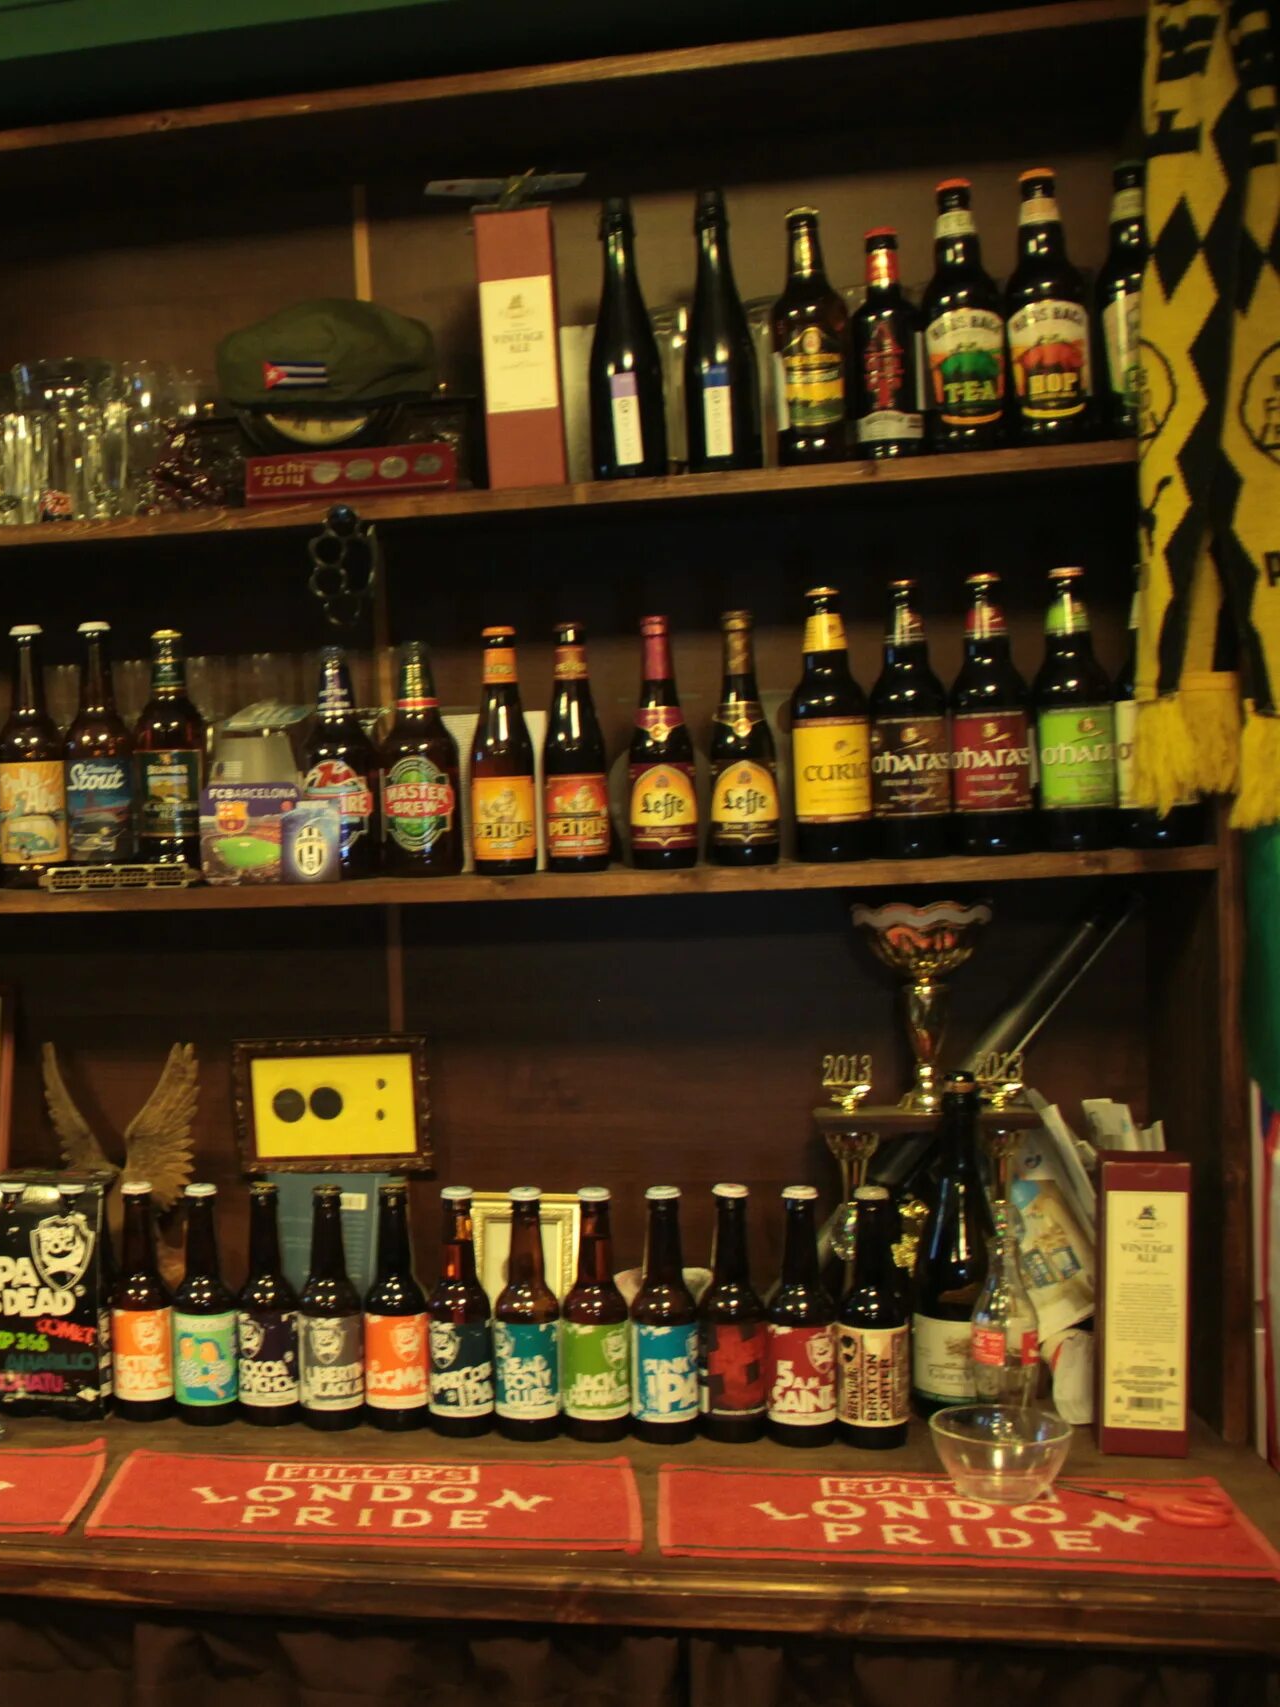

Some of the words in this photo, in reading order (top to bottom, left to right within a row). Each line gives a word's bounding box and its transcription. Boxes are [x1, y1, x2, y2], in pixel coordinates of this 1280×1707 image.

[943, 379, 998, 404] TEA
[66, 763, 127, 791] Stout
[386, 784, 448, 802] MASTER
[639, 792, 685, 820] Leffe
[721, 789, 767, 816] Leffe
[474, 820, 533, 839] PETRUS
[548, 817, 608, 838] PETRUS
[822, 1054, 872, 1083] 2013
[3, 1287, 77, 1317] DEAD
[35, 1319, 97, 1345] COMET
[647, 1372, 699, 1413] IPA
[866, 1353, 878, 1422] BRIXTON
[879, 1357, 891, 1422] PORTER
[281, 1465, 466, 1483] FULLER'S
[191, 1482, 554, 1514] LONDON
[240, 1505, 492, 1529] PRIDE
[753, 1498, 1154, 1536] LONDON
[824, 1521, 1102, 1552] PRIDE
